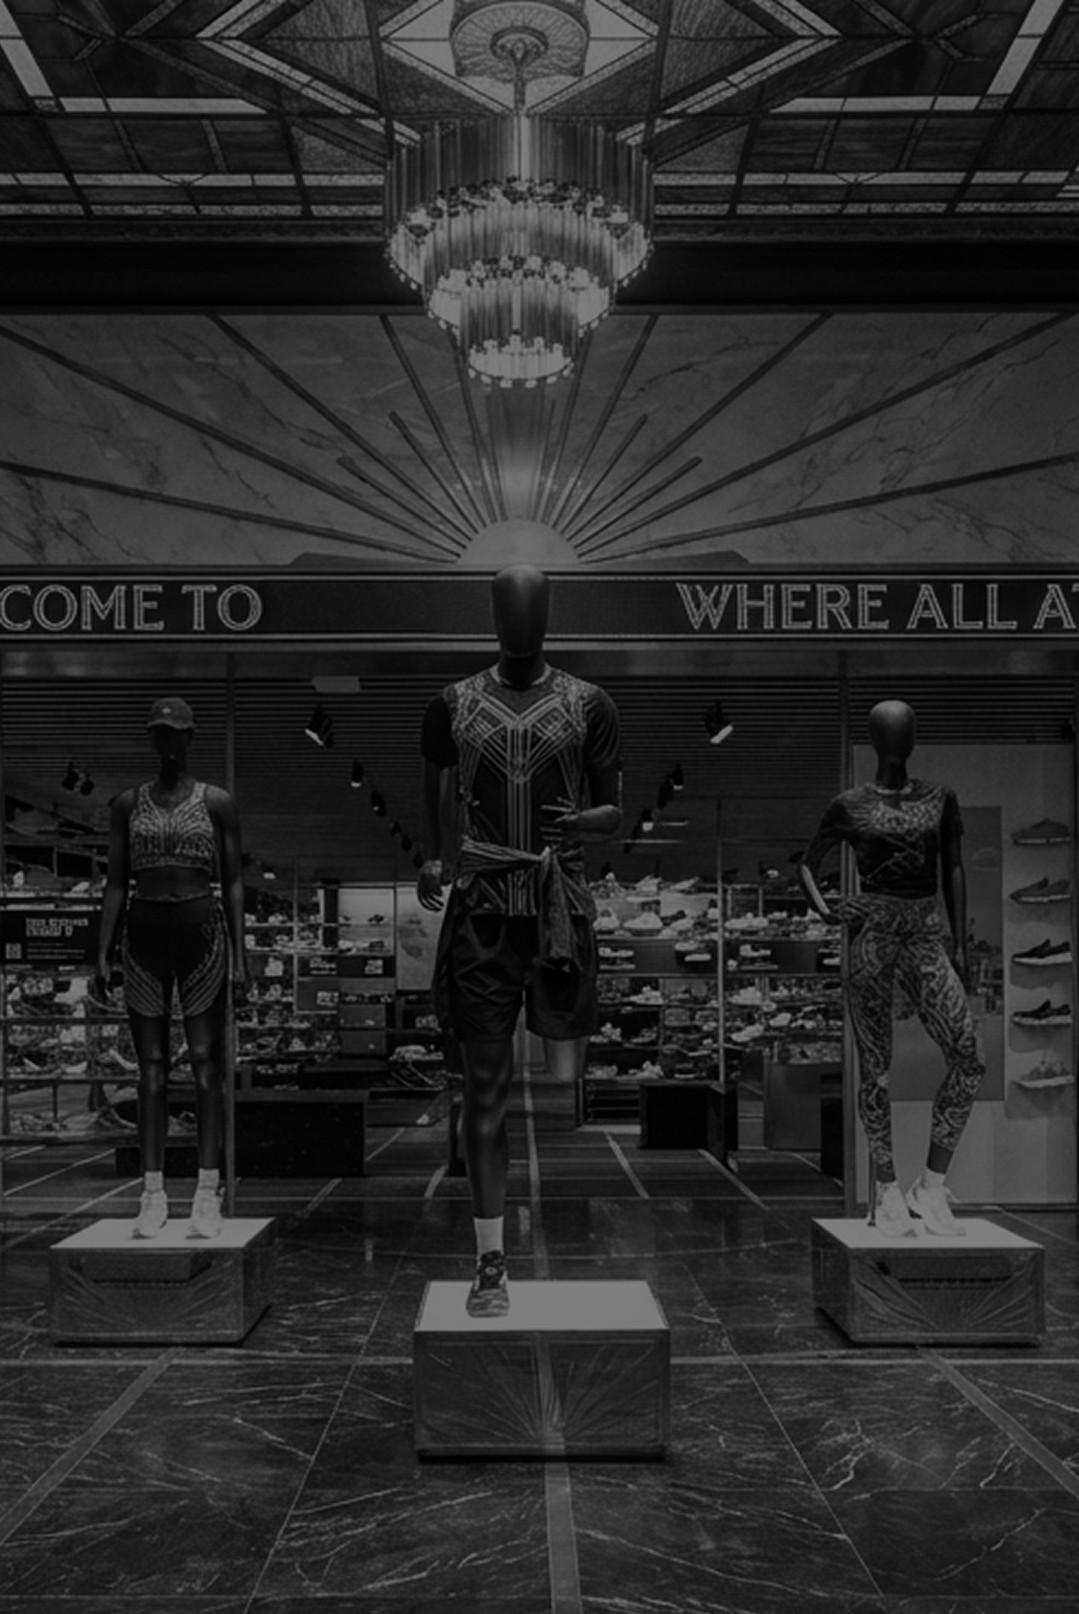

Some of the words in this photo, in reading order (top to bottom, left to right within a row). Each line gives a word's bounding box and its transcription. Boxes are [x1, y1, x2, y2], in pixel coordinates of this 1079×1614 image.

[0, 584, 165, 631] COME
[181, 584, 264, 631] TO
[676, 582, 889, 630] WHERE
[906, 582, 1018, 630] ALL
[1032, 582, 1079, 630] A
